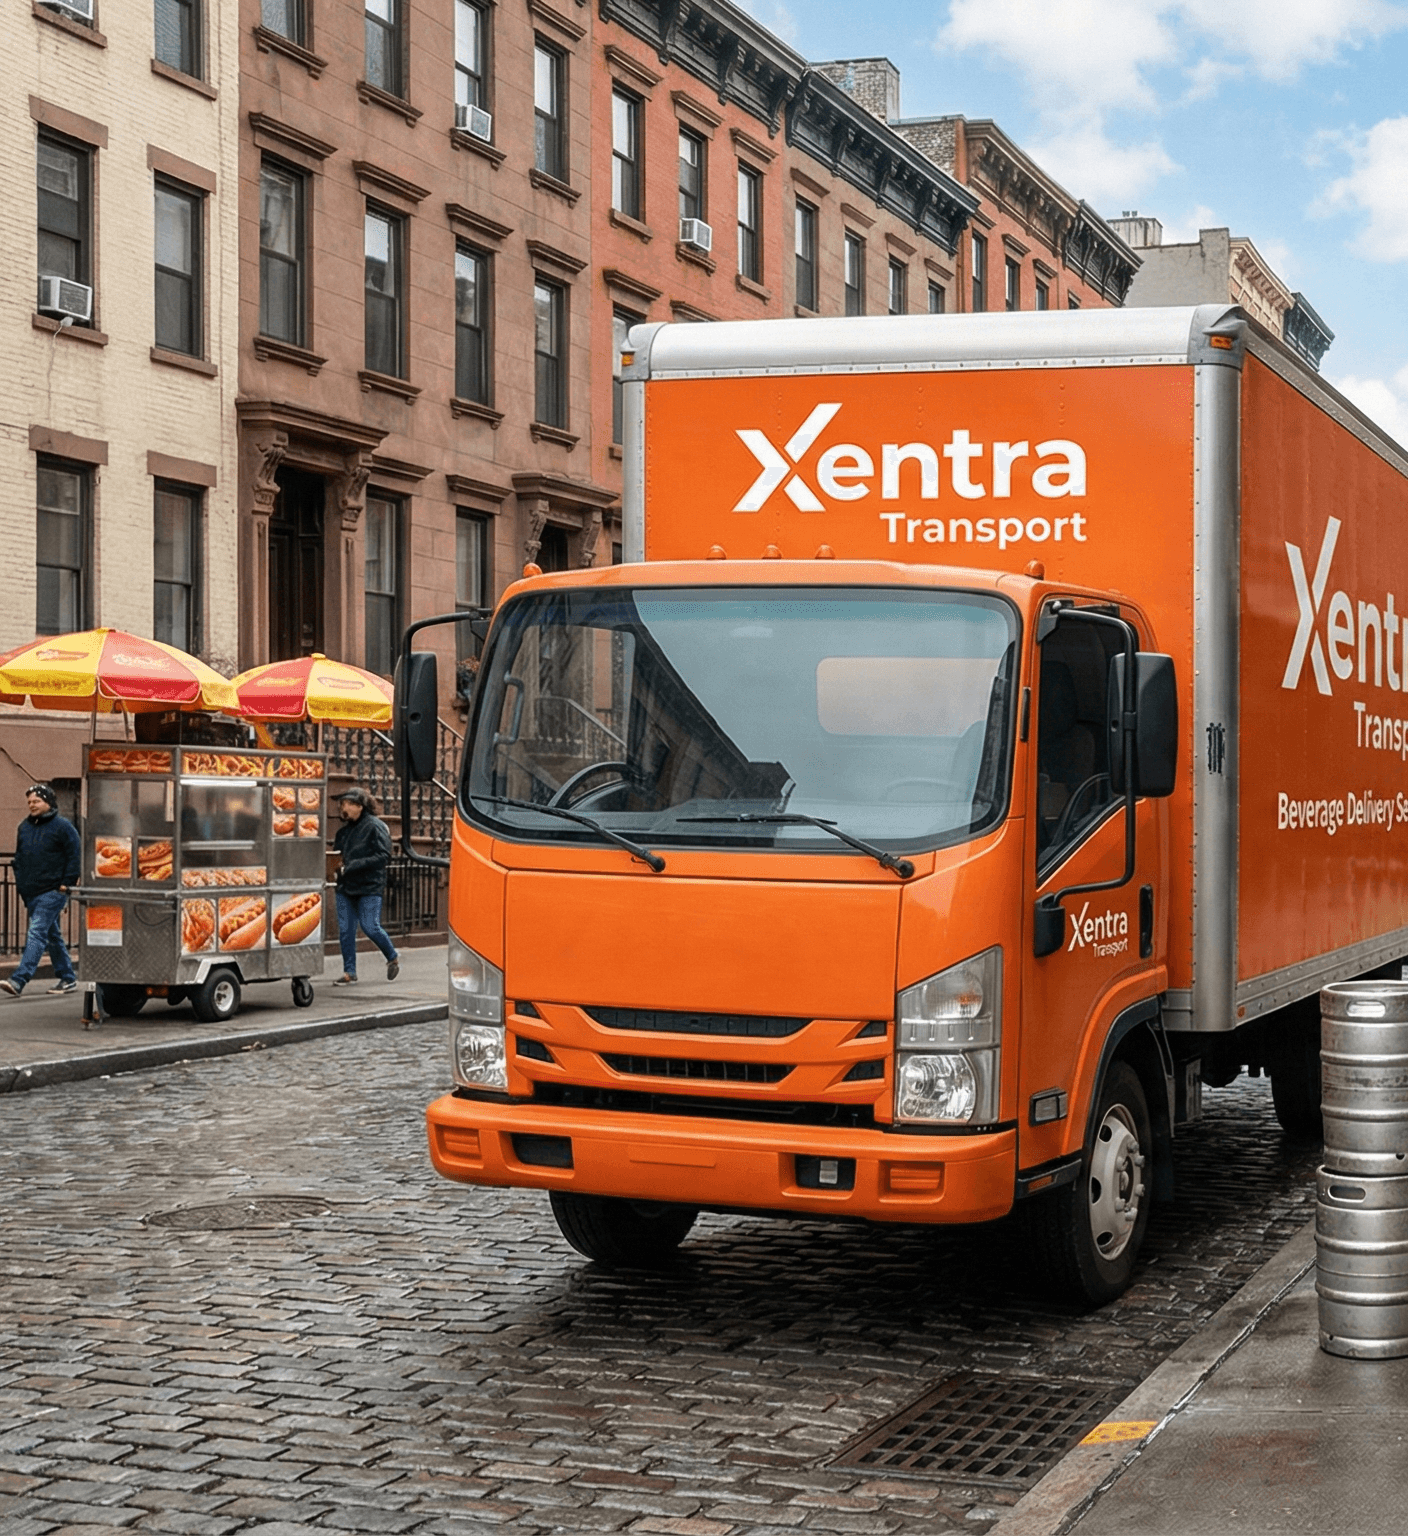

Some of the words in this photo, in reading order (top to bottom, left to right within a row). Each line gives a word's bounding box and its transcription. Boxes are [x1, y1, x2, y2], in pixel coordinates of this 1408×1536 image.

[732, 402, 1087, 513] Xentra
[879, 512, 1087, 550] Transport
[1277, 791, 1345, 836] Beverage
[1347, 789, 1395, 832] Delivery
[1067, 901, 1128, 952] Xentra
